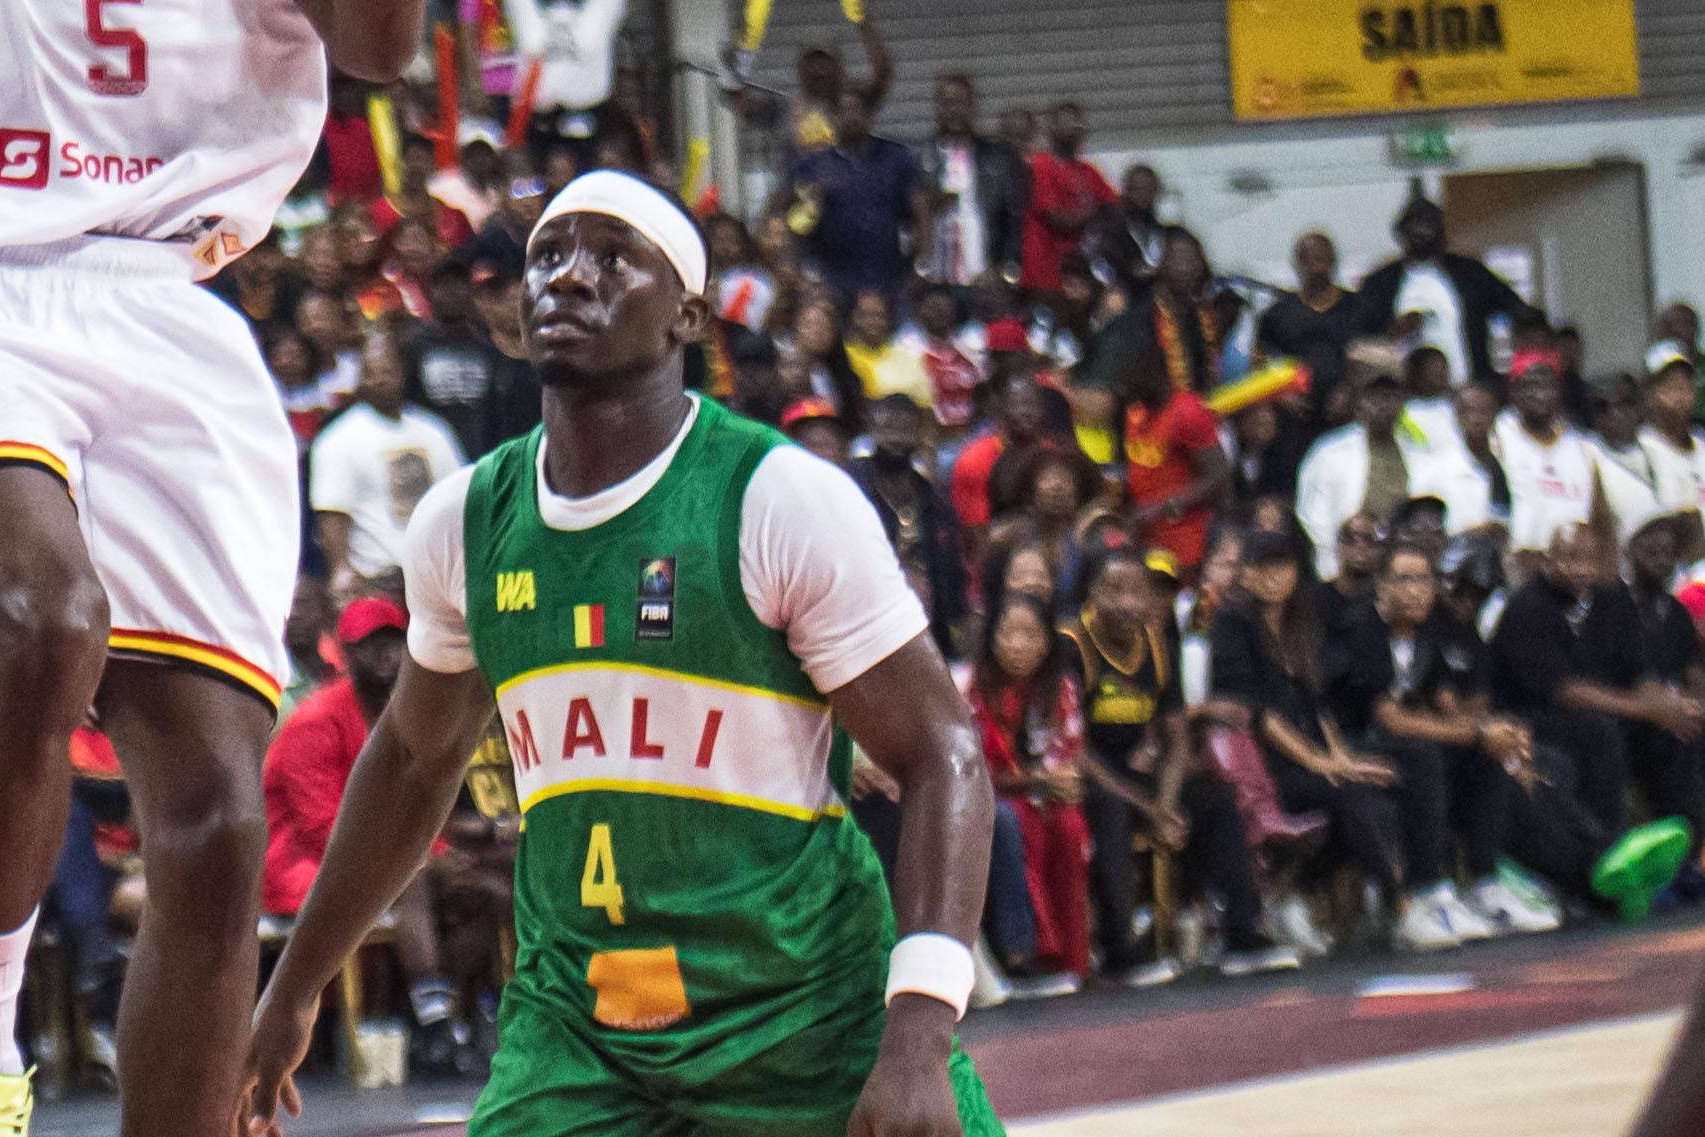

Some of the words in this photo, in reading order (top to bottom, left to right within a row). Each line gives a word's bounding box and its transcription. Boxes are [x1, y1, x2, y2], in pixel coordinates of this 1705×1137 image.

[641, 603, 669, 621] FIBA
[506, 696, 725, 778] MALI
[580, 823, 625, 925] 4
